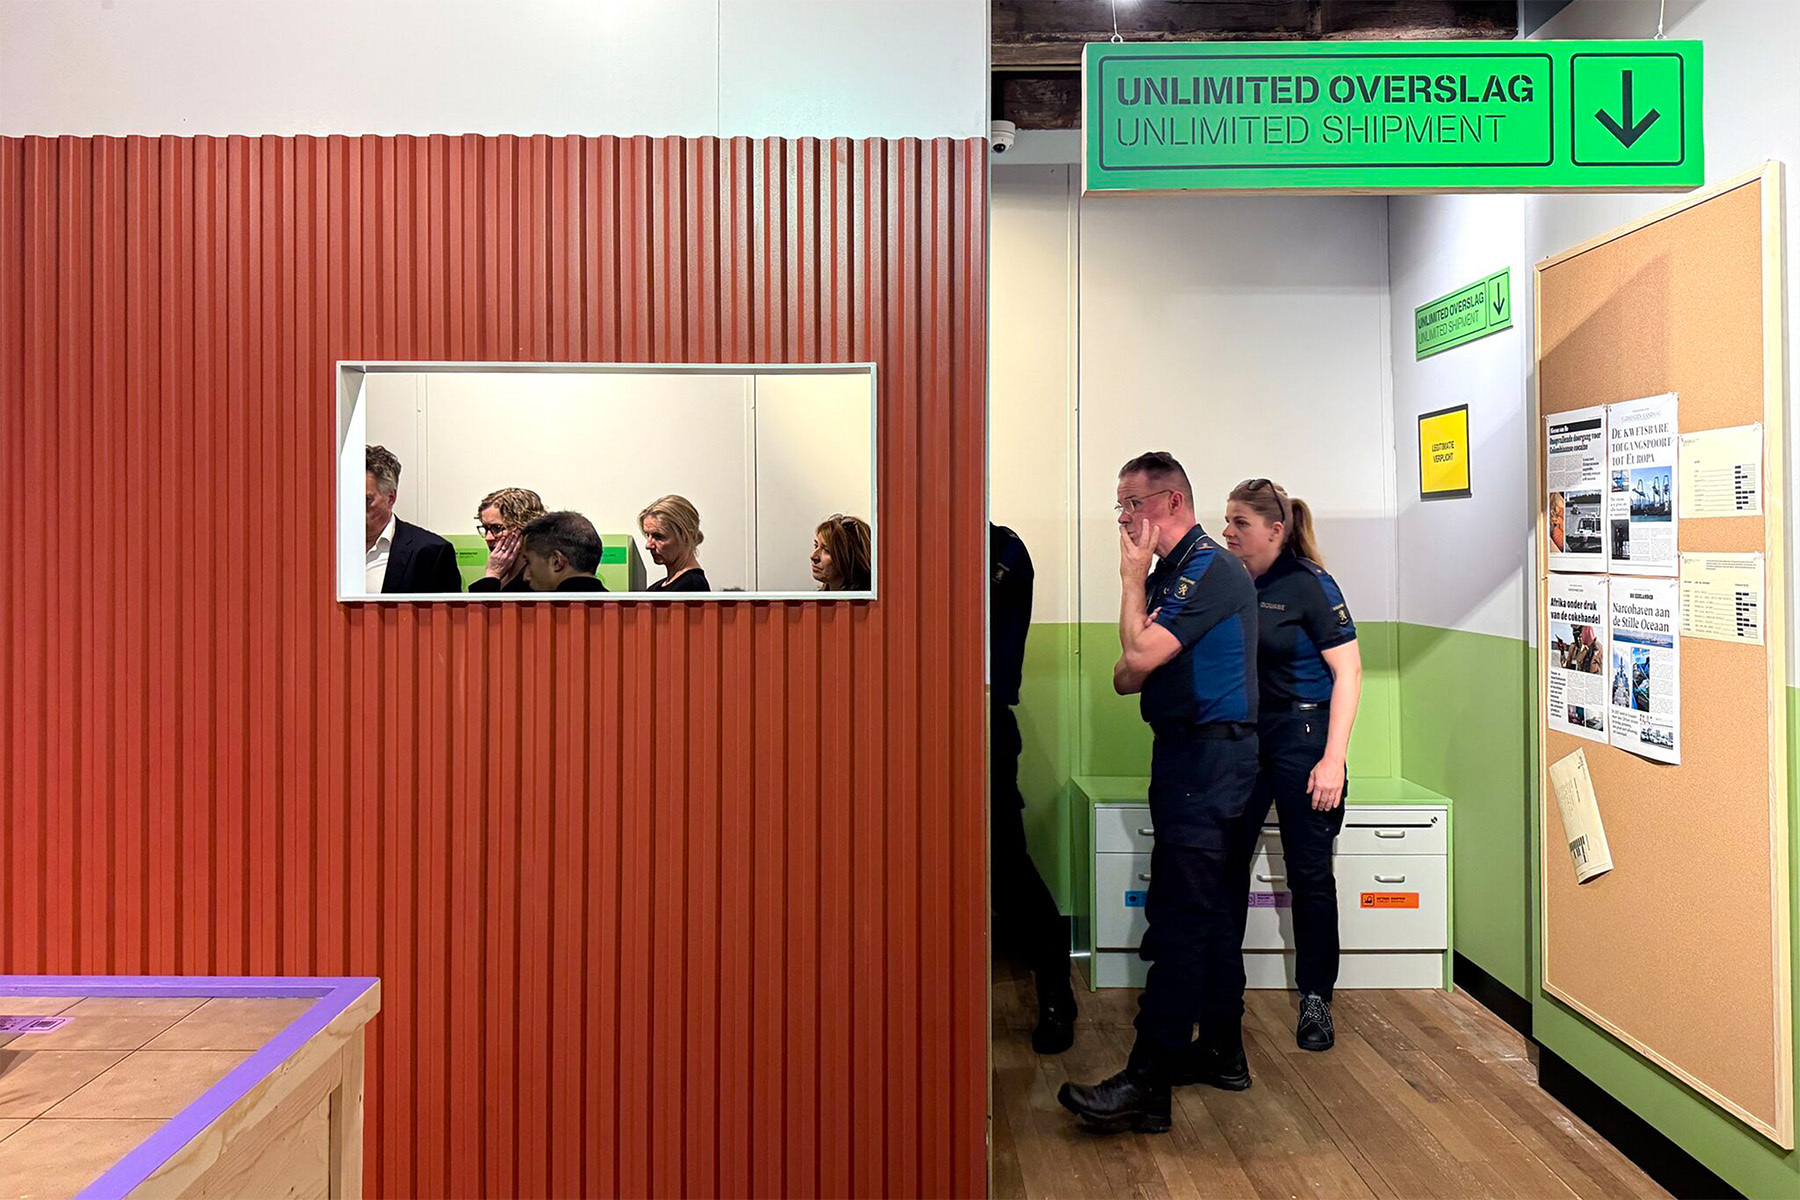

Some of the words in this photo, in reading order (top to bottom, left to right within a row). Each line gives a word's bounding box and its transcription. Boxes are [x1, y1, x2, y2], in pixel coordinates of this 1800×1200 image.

[1117, 76, 1319, 106] UNLIMITED
[1328, 75, 1534, 105] OVERSLAG
[1117, 117, 1308, 147] UNLIMITED
[1322, 115, 1507, 144] SHIPMENT
[1418, 307, 1448, 329] UNLIMITED
[1450, 292, 1484, 316] OVERSLAG
[1418, 322, 1447, 345] UNLIMITED
[1449, 310, 1479, 333] SHIPMENT
[1550, 597, 1566, 608] Afrika
[1567, 599, 1583, 610] onder
[1583, 601, 1597, 611] druk
[1613, 603, 1654, 617] Narcohaven
[1655, 607, 1670, 618] aan
[1550, 611, 1560, 620] van
[1561, 611, 1567, 620] de
[1568, 611, 1601, 625] cokehandel
[1613, 616, 1621, 626] de
[1622, 617, 1639, 629] Stille
[1640, 619, 1670, 632] Oceaan
